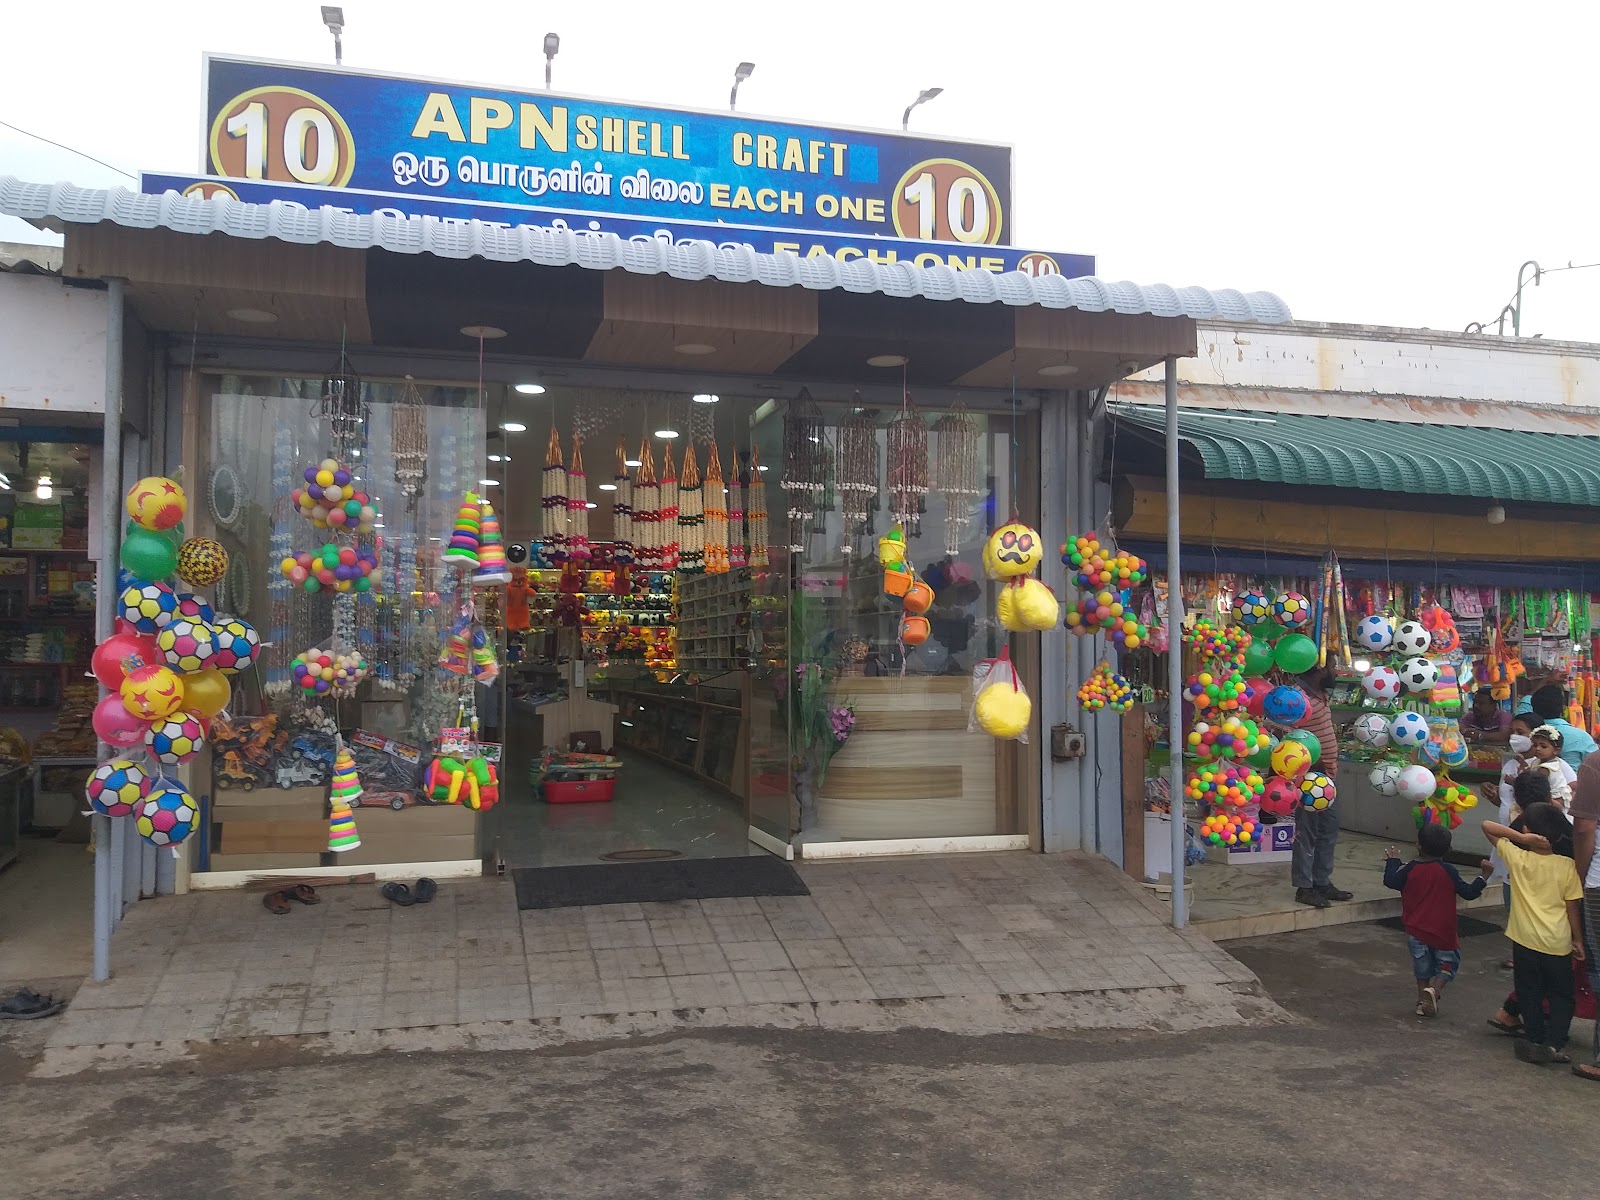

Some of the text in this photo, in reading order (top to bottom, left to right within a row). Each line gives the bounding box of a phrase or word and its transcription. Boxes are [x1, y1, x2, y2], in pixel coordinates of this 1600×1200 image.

[227, 102, 341, 184] 10
[411, 92, 848, 176] APN SHELL CRAFT
[392, 151, 886, 223] ஒரு பொருளின் விலை EACH ONE
[903, 172, 991, 243] 10
[1143, 688, 1153, 702] 20
